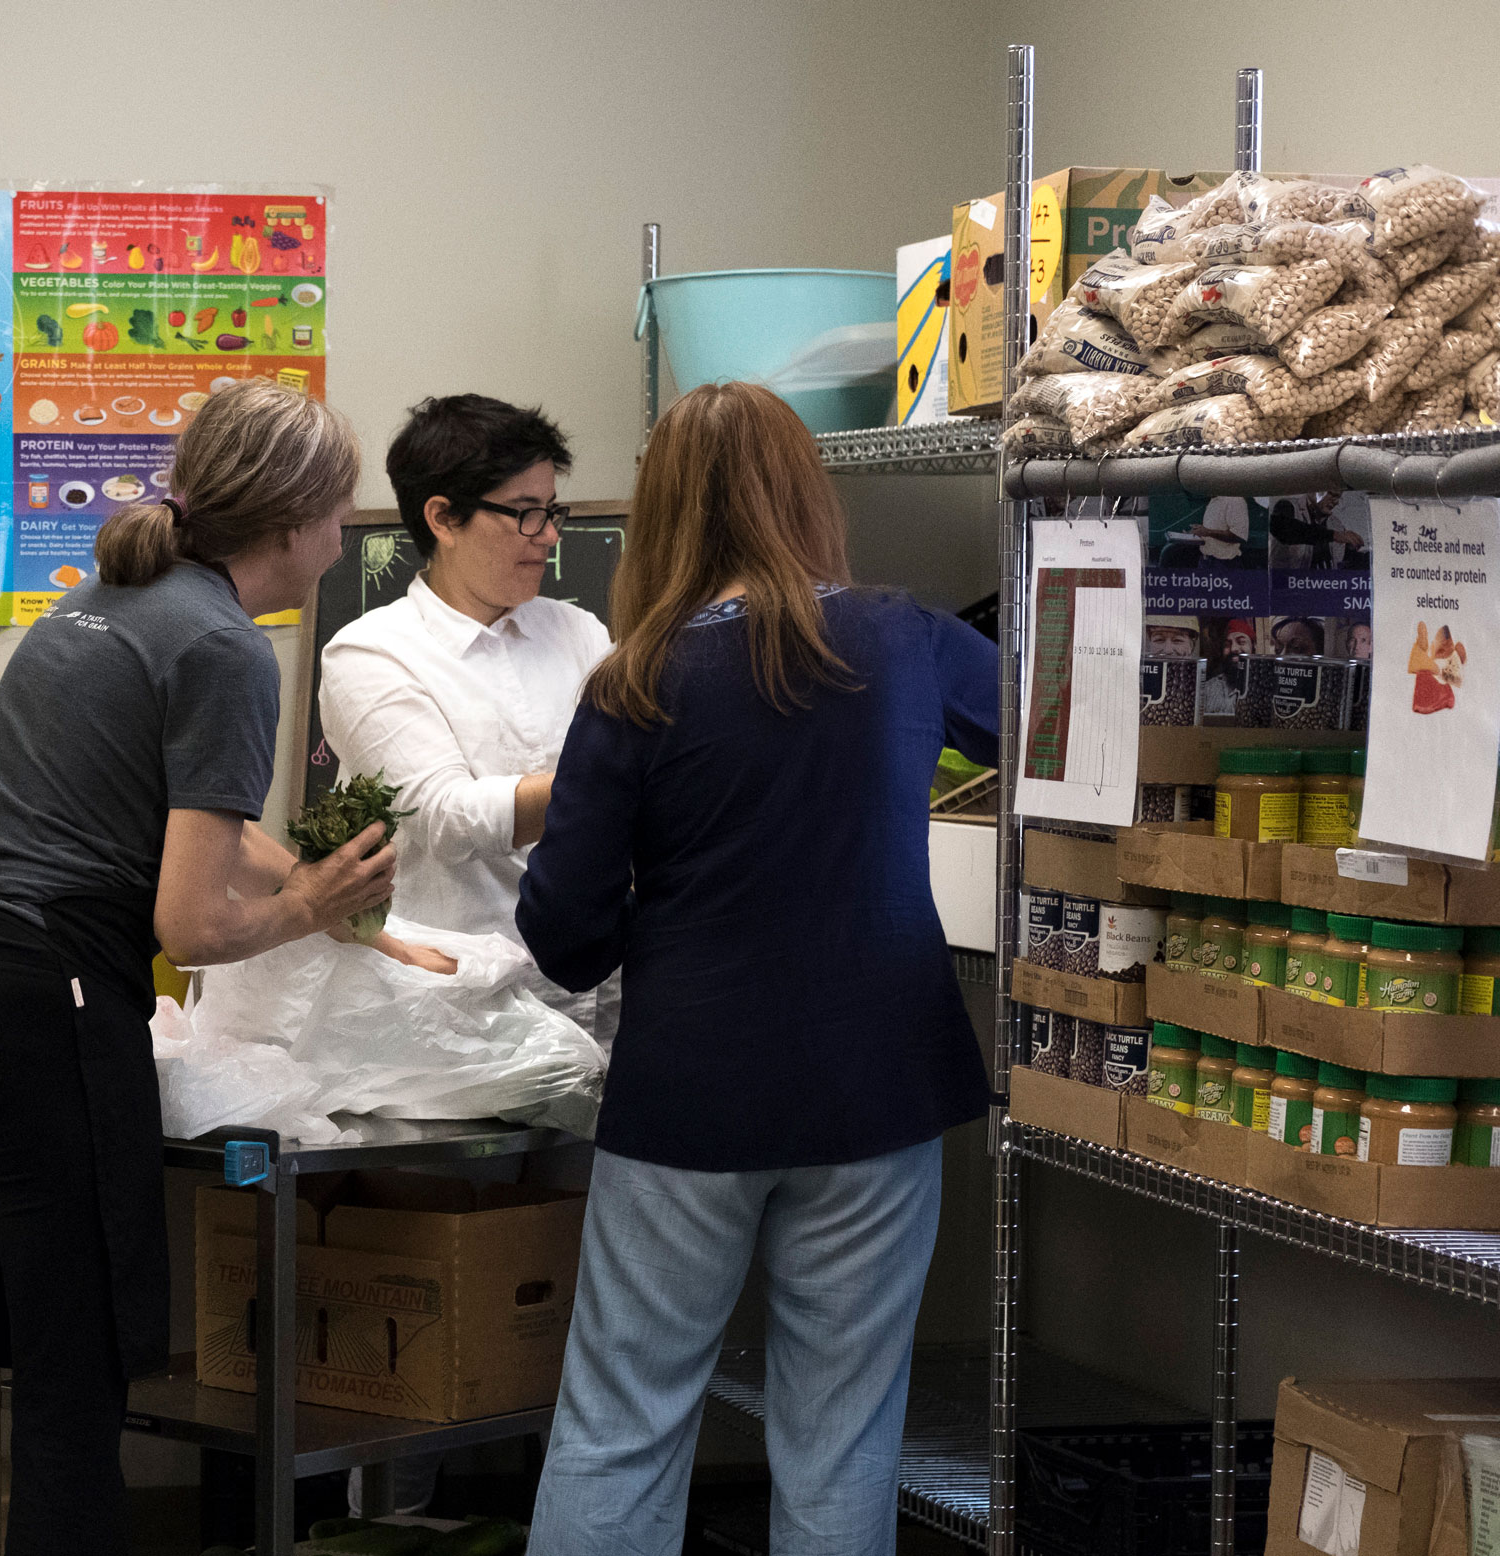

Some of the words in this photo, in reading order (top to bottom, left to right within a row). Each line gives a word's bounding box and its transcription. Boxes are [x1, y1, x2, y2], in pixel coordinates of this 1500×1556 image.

[20, 200, 64, 211] FRUITS
[20, 277, 100, 288] VEGETABLES
[102, 281, 125, 289] Color
[127, 281, 146, 289] Your
[148, 281, 169, 289] Plate
[171, 282, 191, 290] With
[250, 283, 282, 293] Veggies
[1100, 333, 1120, 346] PEAS
[20, 359, 67, 369] GRAINS
[93, 362, 102, 370] at
[147, 363, 166, 371] Your
[196, 363, 223, 371] Whole
[226, 363, 252, 371] Grains
[1081, 346, 1115, 372] RABBIT
[20, 440, 74, 450] PROTEIN
[77, 443, 96, 452] Vary
[98, 443, 117, 451] Your
[119, 443, 149, 451] Protein
[20, 521, 59, 531] DAIRY
[1080, 539, 1095, 547] Protein
[1390, 536, 1411, 554] Eggs,
[1413, 537, 1443, 552] cheese
[1444, 539, 1460, 554] and
[1463, 541, 1485, 556] meat
[1391, 566, 1404, 579] are
[1406, 566, 1441, 581] counted
[1443, 569, 1452, 582] as
[1454, 569, 1487, 585] protein
[1171, 573, 1233, 593] trabajos,
[1288, 576, 1348, 590] Between
[1351, 577, 1372, 590] Shi
[1178, 597, 1208, 612] para
[1211, 595, 1254, 610] usted.
[1343, 597, 1372, 610] SNA
[1417, 593, 1460, 611] selections
[1088, 647, 1095, 655] 10
[1143, 666, 1159, 674] RTLE
[1288, 667, 1313, 678] TURTLE
[1278, 676, 1297, 687] BEANS
[1036, 896, 1059, 906] TURTLE
[1072, 903, 1095, 912] TURTLE
[1030, 905, 1046, 915] BEANS
[1066, 911, 1082, 921] BEANS
[1106, 931, 1123, 941] Black
[1125, 933, 1151, 944] Beans
[1380, 979, 1420, 998] Hampton
[1391, 989, 1416, 1006] Farms
[1118, 1034, 1144, 1046] TURTLE
[1110, 1043, 1129, 1054] BEANS
[1198, 1082, 1226, 1097] Hampton
[323, 1278, 425, 1309] MOUNTAIN
[306, 1370, 405, 1400] TOMATOES
